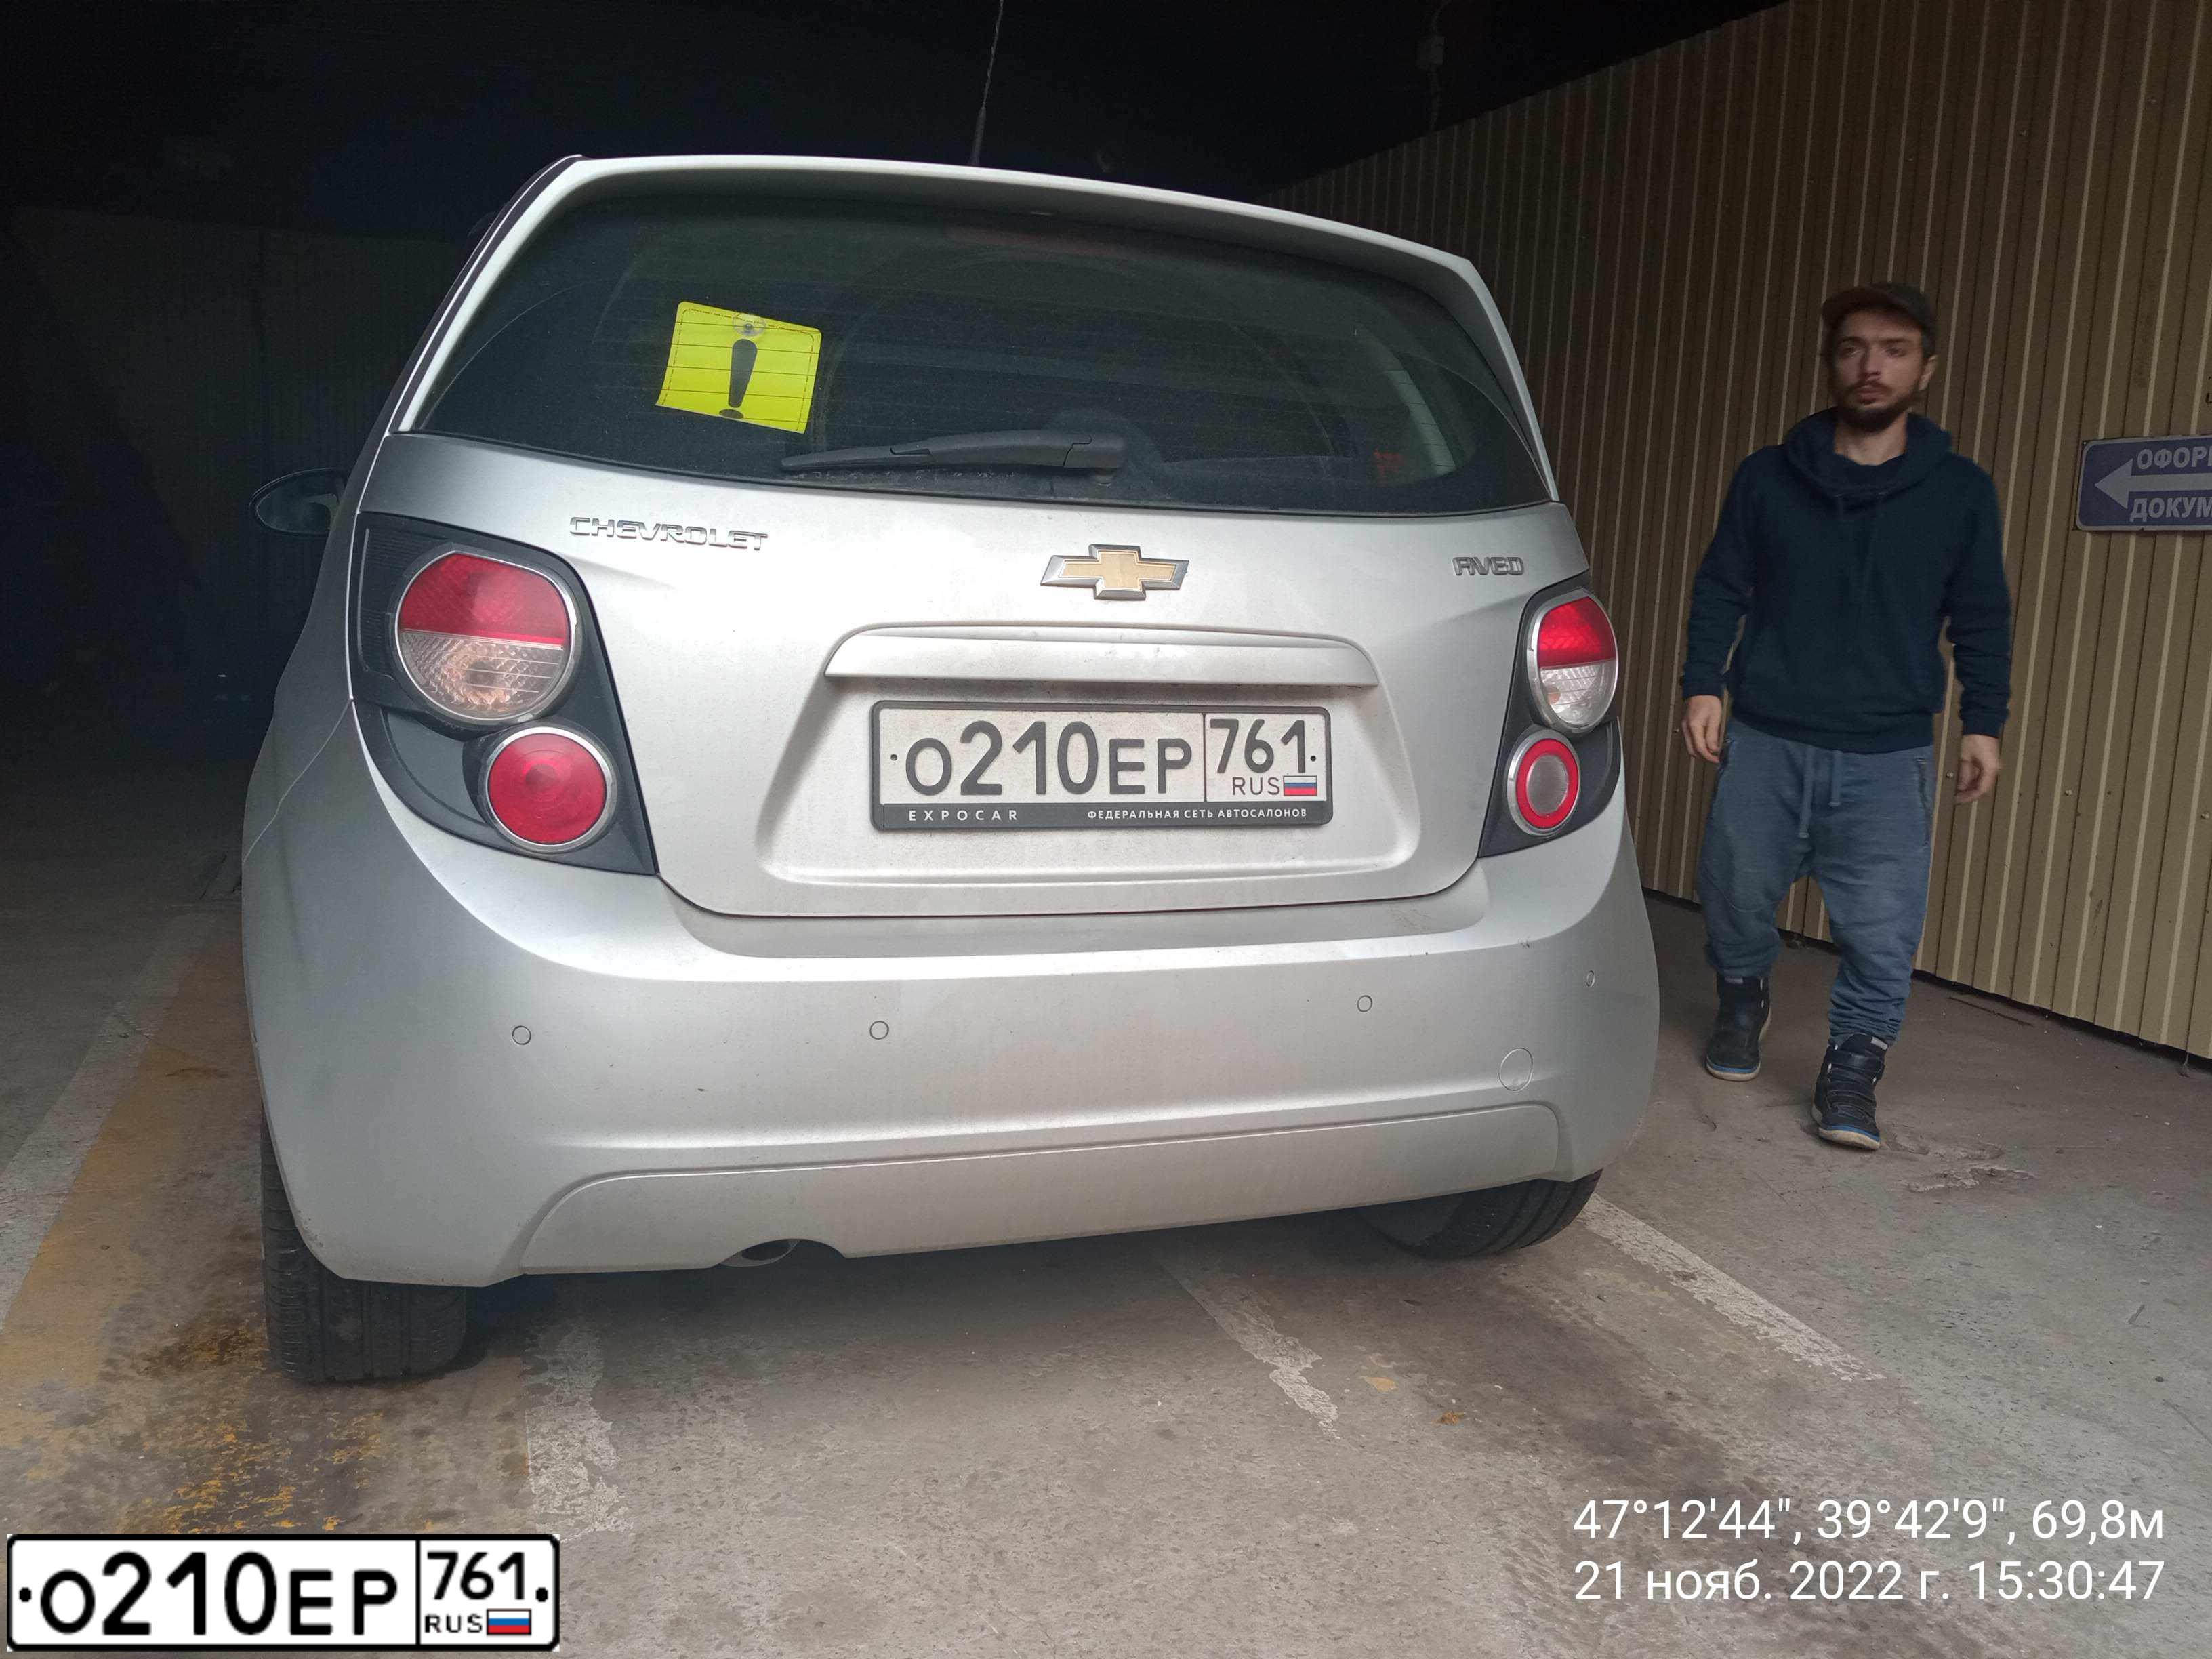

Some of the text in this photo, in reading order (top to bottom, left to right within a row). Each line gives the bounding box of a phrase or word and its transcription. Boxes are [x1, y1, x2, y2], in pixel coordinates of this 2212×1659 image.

[570, 516, 769, 551] CHEVROLET
[1452, 556, 1524, 576] AVEO
[905, 718, 1305, 796] О210ЕР 761
[1231, 777, 1280, 796] RUS
[908, 809, 1017, 821] EXPOCAR
[1087, 808, 1307, 819] ФЕДЕРАЛЬНАЯ СЕТЬ АВТОСАЛОНОВ
